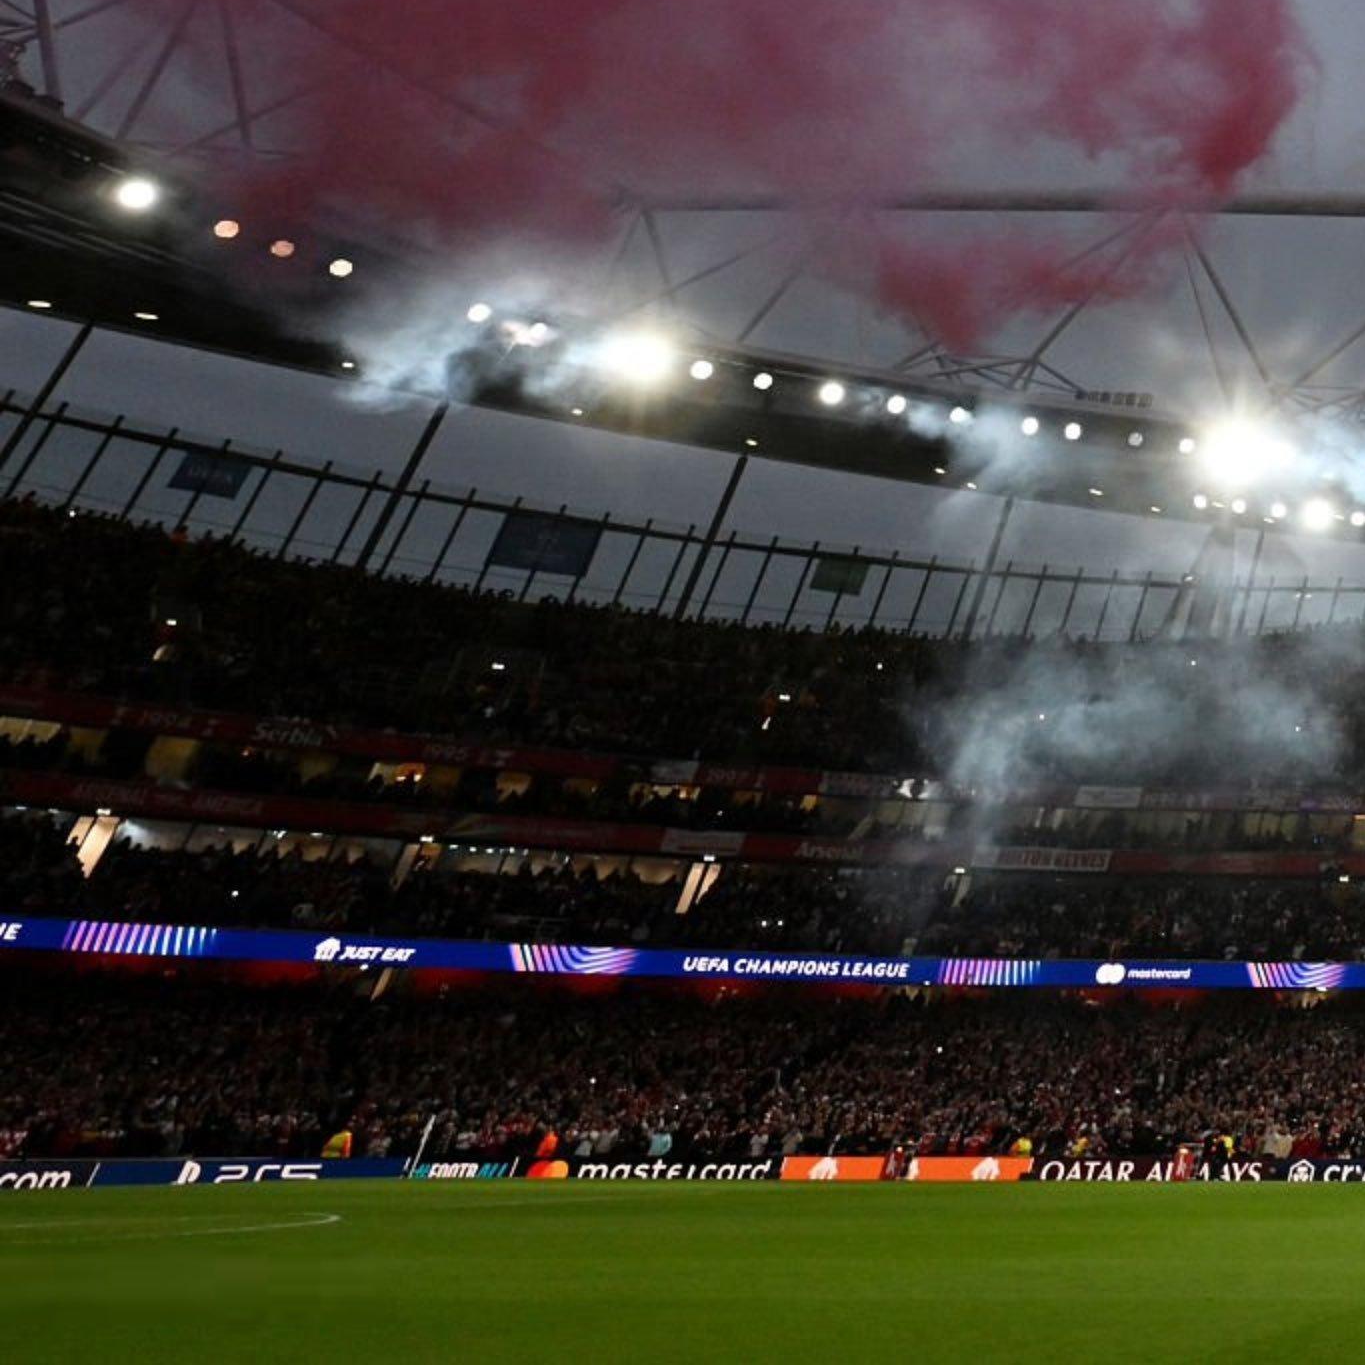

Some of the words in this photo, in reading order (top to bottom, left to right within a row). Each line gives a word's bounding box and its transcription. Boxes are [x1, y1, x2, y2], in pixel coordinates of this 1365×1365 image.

[338, 945, 382, 961] JUST
[380, 947, 417, 962] EAT
[683, 956, 729, 973] UEFA
[733, 959, 840, 977] CHAMPIONS
[841, 961, 910, 978] LEAGUE
[1127, 968, 1192, 980] mastercard
[1039, 1161, 1136, 1181] QATAR
[1146, 1161, 1263, 1181] AIAYS
